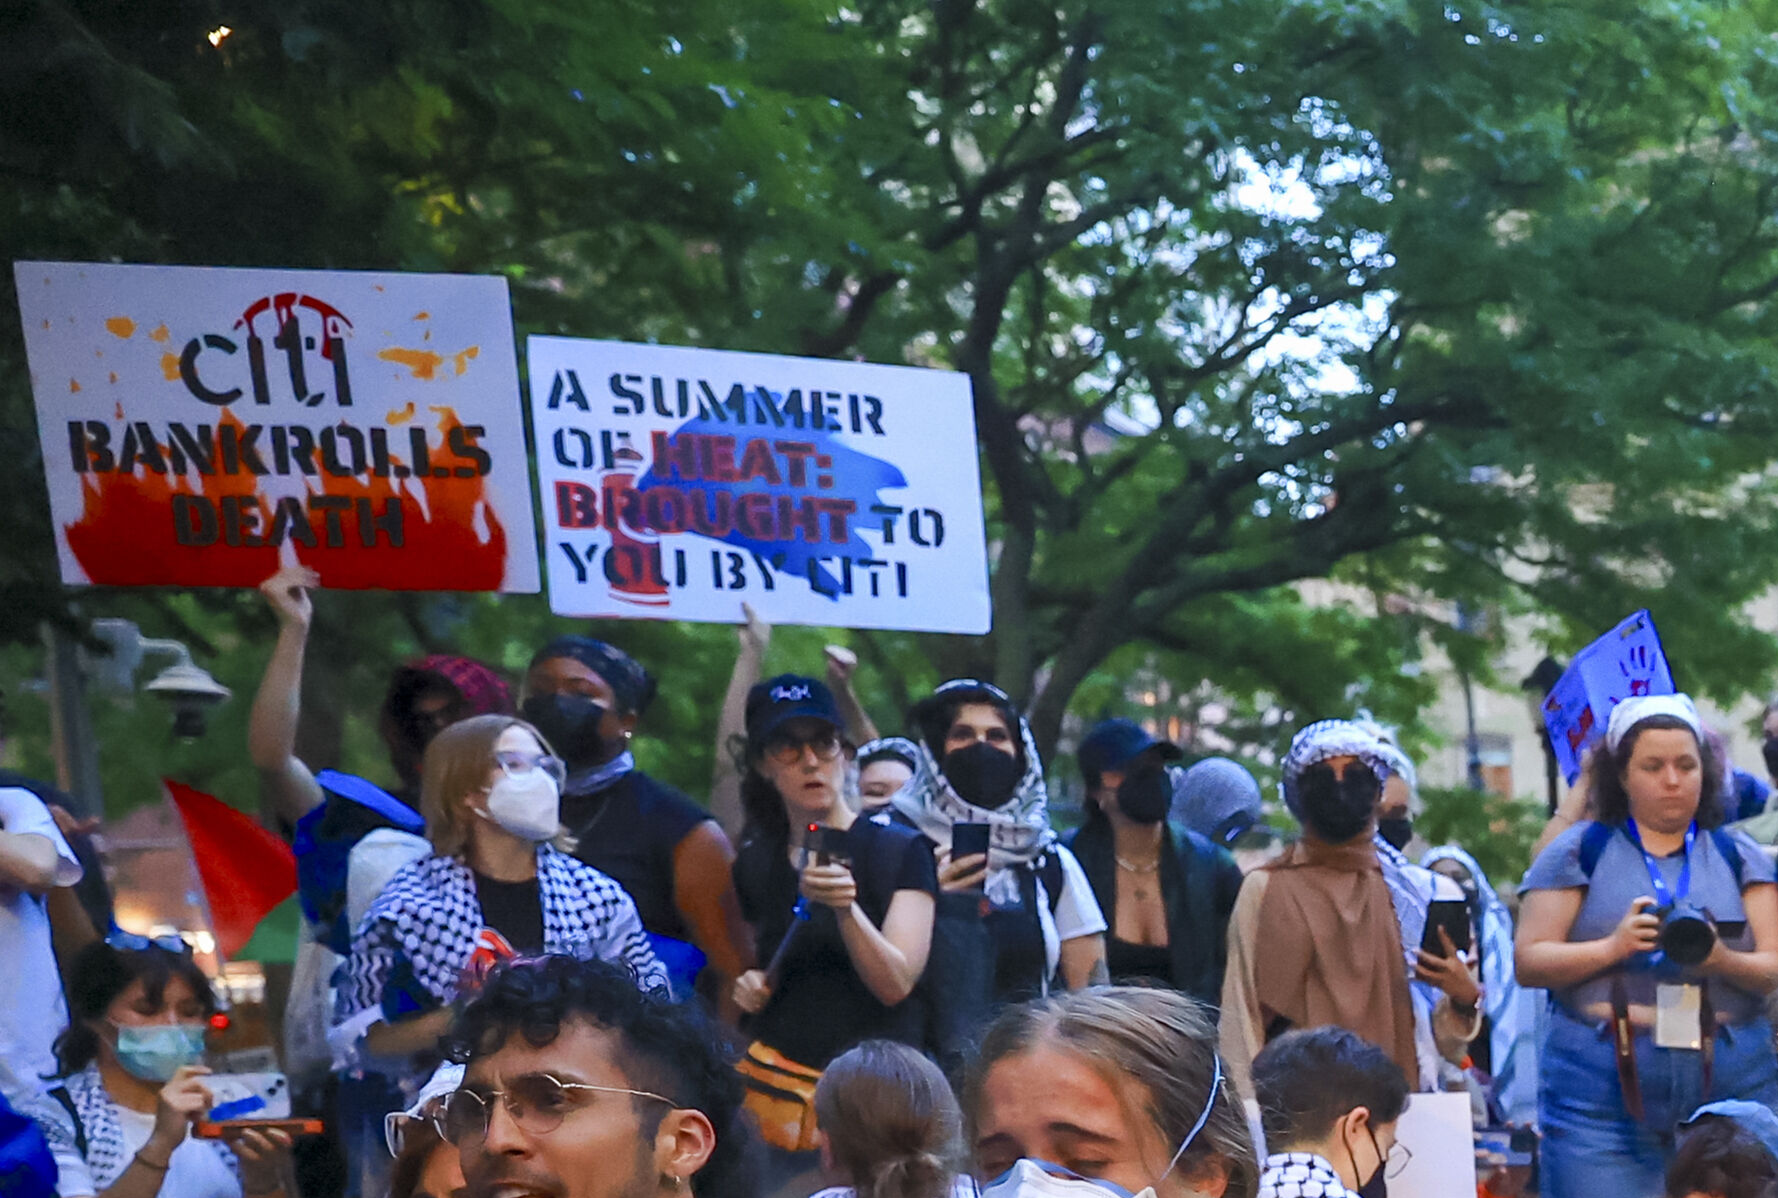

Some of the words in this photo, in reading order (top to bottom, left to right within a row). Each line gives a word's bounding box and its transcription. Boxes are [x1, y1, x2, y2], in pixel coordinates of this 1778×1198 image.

[547, 369, 591, 413] A
[608, 372, 885, 436] SUMMER
[68, 421, 493, 478] BANKROLLS
[553, 427, 631, 469] OF
[650, 430, 834, 489] HEAT:
[171, 493, 406, 549] DEATH
[554, 480, 857, 543] BROUGHT
[870, 505, 946, 548] TO
[560, 541, 687, 589] YOU
[712, 550, 787, 592] BY
[807, 556, 908, 599] CITI
